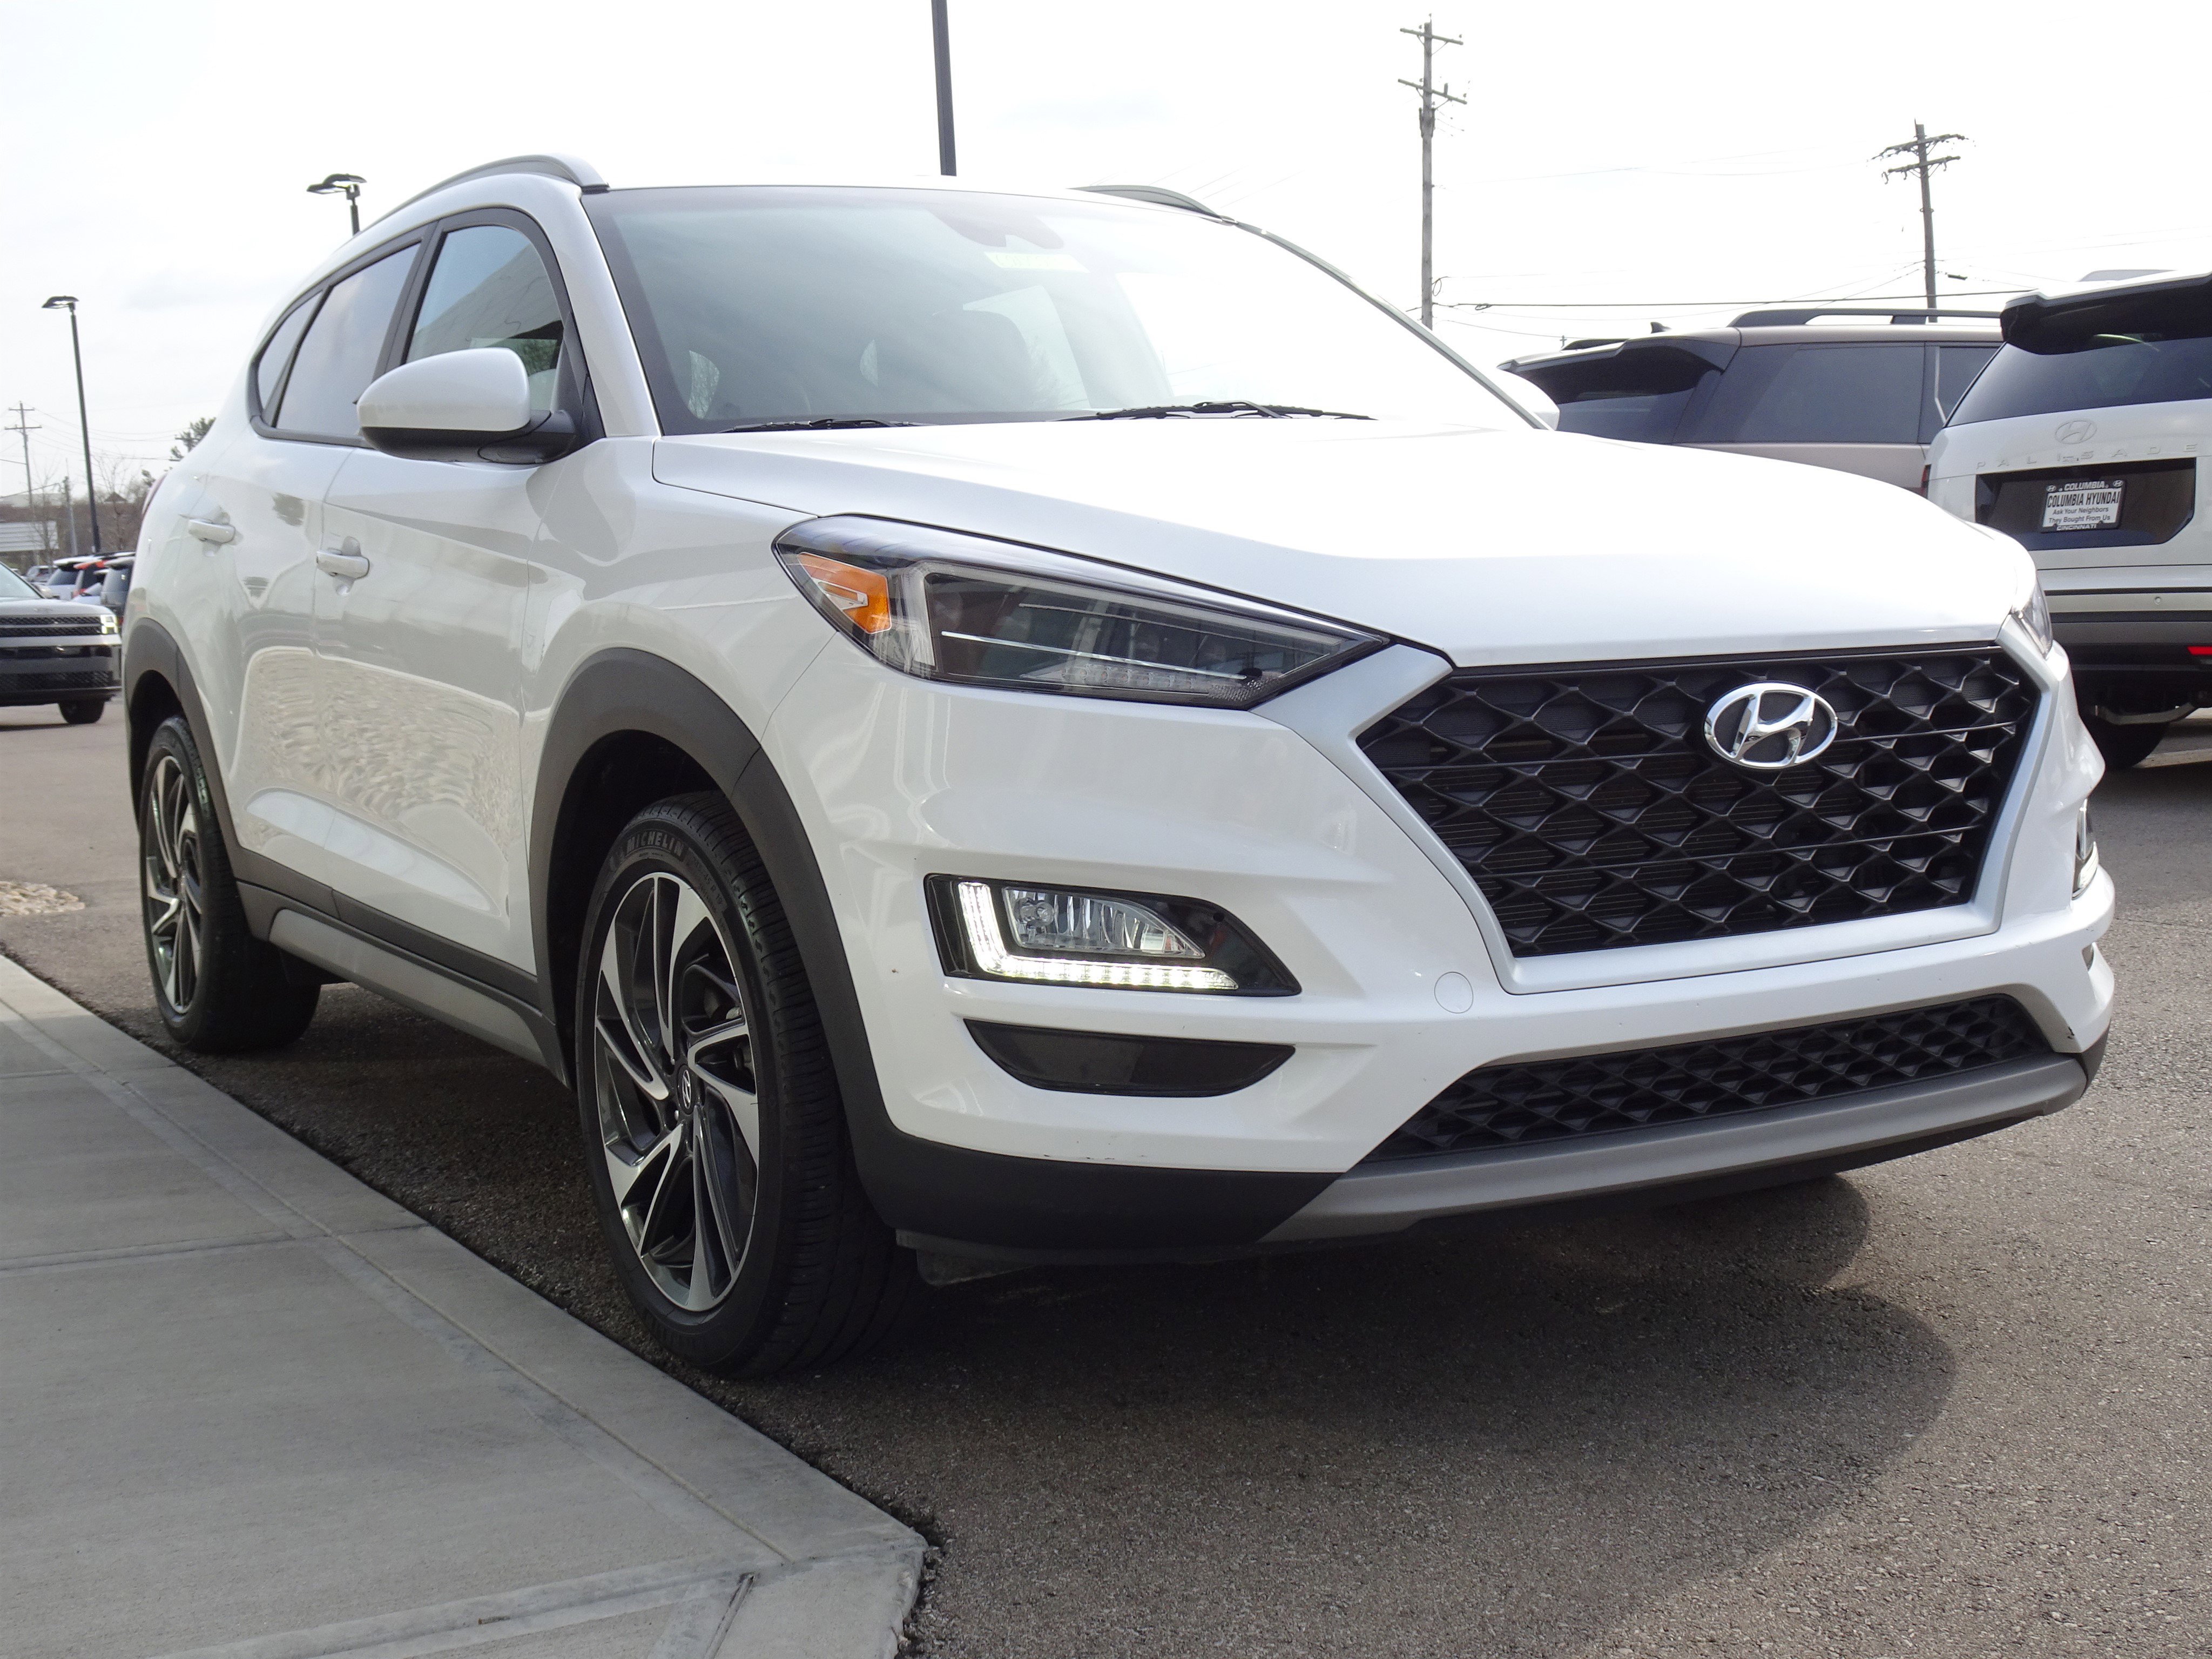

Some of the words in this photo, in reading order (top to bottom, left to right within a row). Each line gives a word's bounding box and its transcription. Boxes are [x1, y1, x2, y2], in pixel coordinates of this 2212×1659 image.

[1975, 443, 2198, 470] PALISADE
[2065, 481, 2105, 490] COLUMBIA
[2047, 493, 2083, 508] COLUMBIA
[2086, 491, 2120, 505] HYUNDAI
[626, 831, 684, 857] MICHELIN
